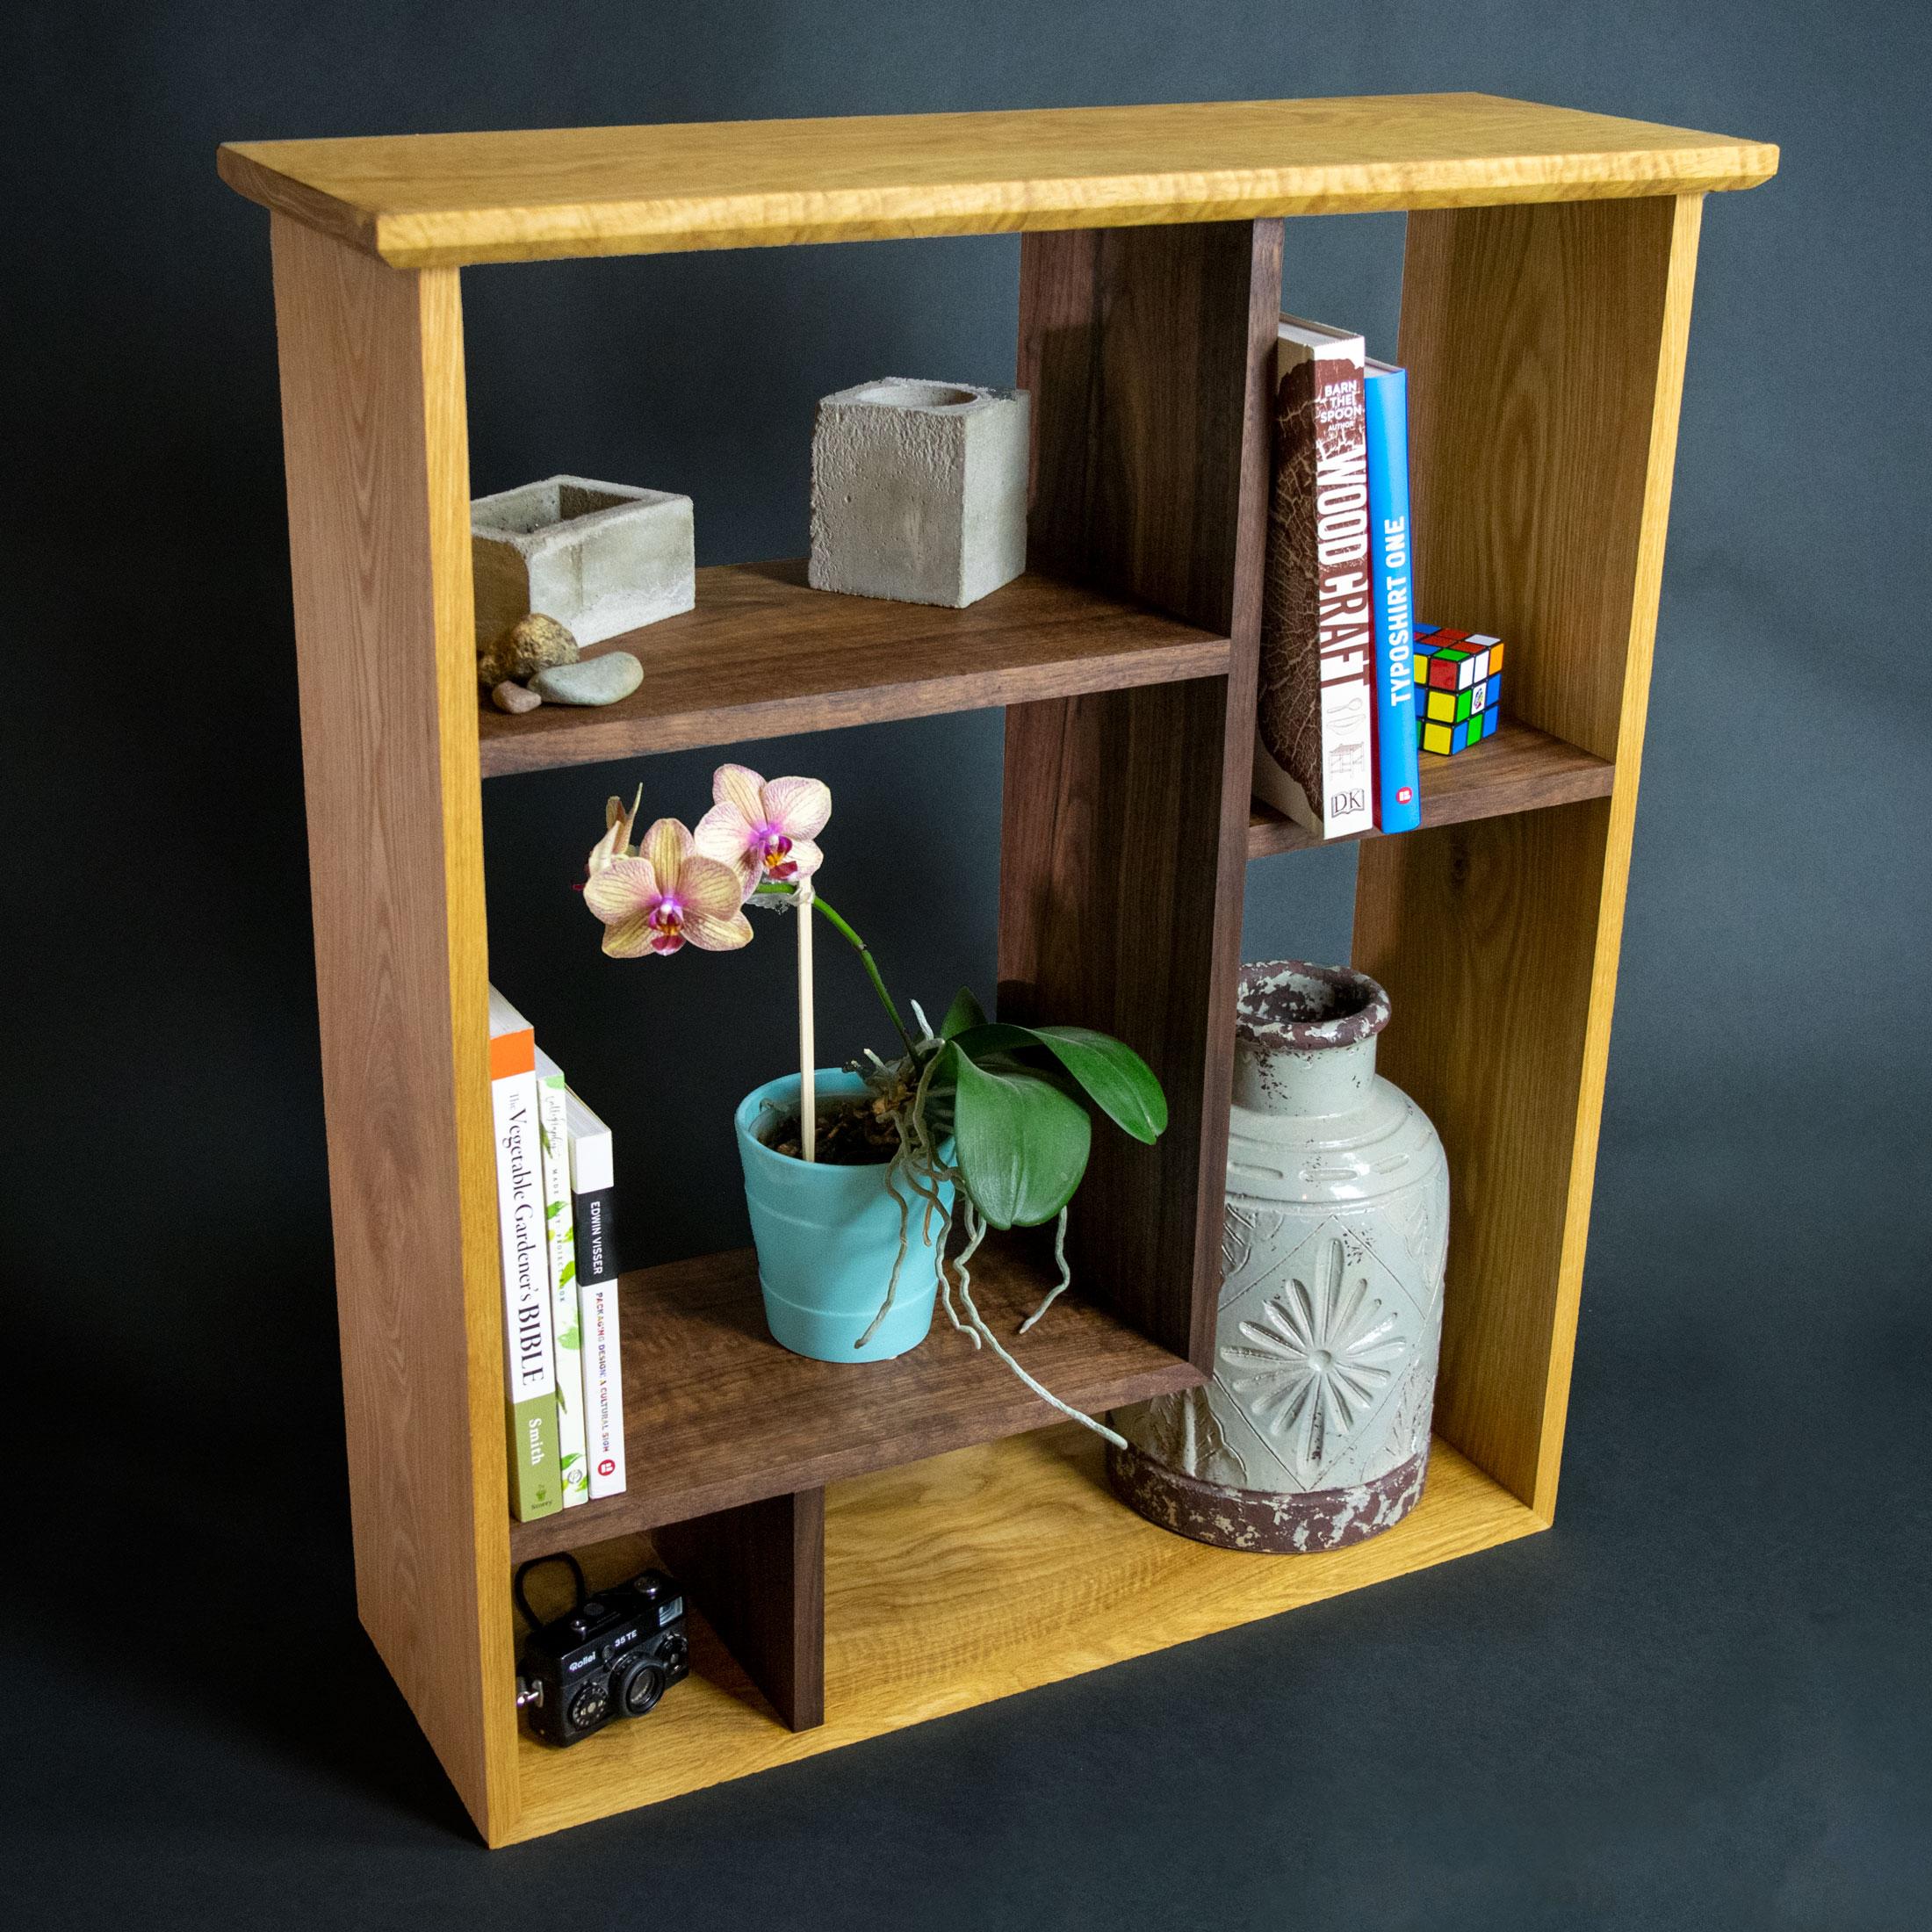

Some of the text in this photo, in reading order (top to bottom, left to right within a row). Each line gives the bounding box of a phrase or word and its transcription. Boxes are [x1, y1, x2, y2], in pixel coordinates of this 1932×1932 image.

[1320, 405, 1362, 423] SPOON
[1324, 379, 1357, 397] BARN
[1330, 393, 1353, 409] THE
[1327, 421, 1355, 431] AUTHOR
[1316, 446, 1370, 689] WOOD CRAFT
[1384, 515, 1412, 707] TYPOSHIRT ONE
[1334, 789, 1362, 814] DK
[501, 1108, 532, 1201] Vegetable
[514, 1203, 539, 1302] Gardener's
[590, 1200, 603, 1275] EDWIN VISSER
[518, 1303, 544, 1387] BIBLE
[595, 1292, 605, 1343] PACKAGING
[600, 1388, 609, 1431] CULTURAL
[529, 1417, 545, 1467] Smith
[615, 1636, 626, 1647] 35
[626, 1629, 638, 1640] TE
